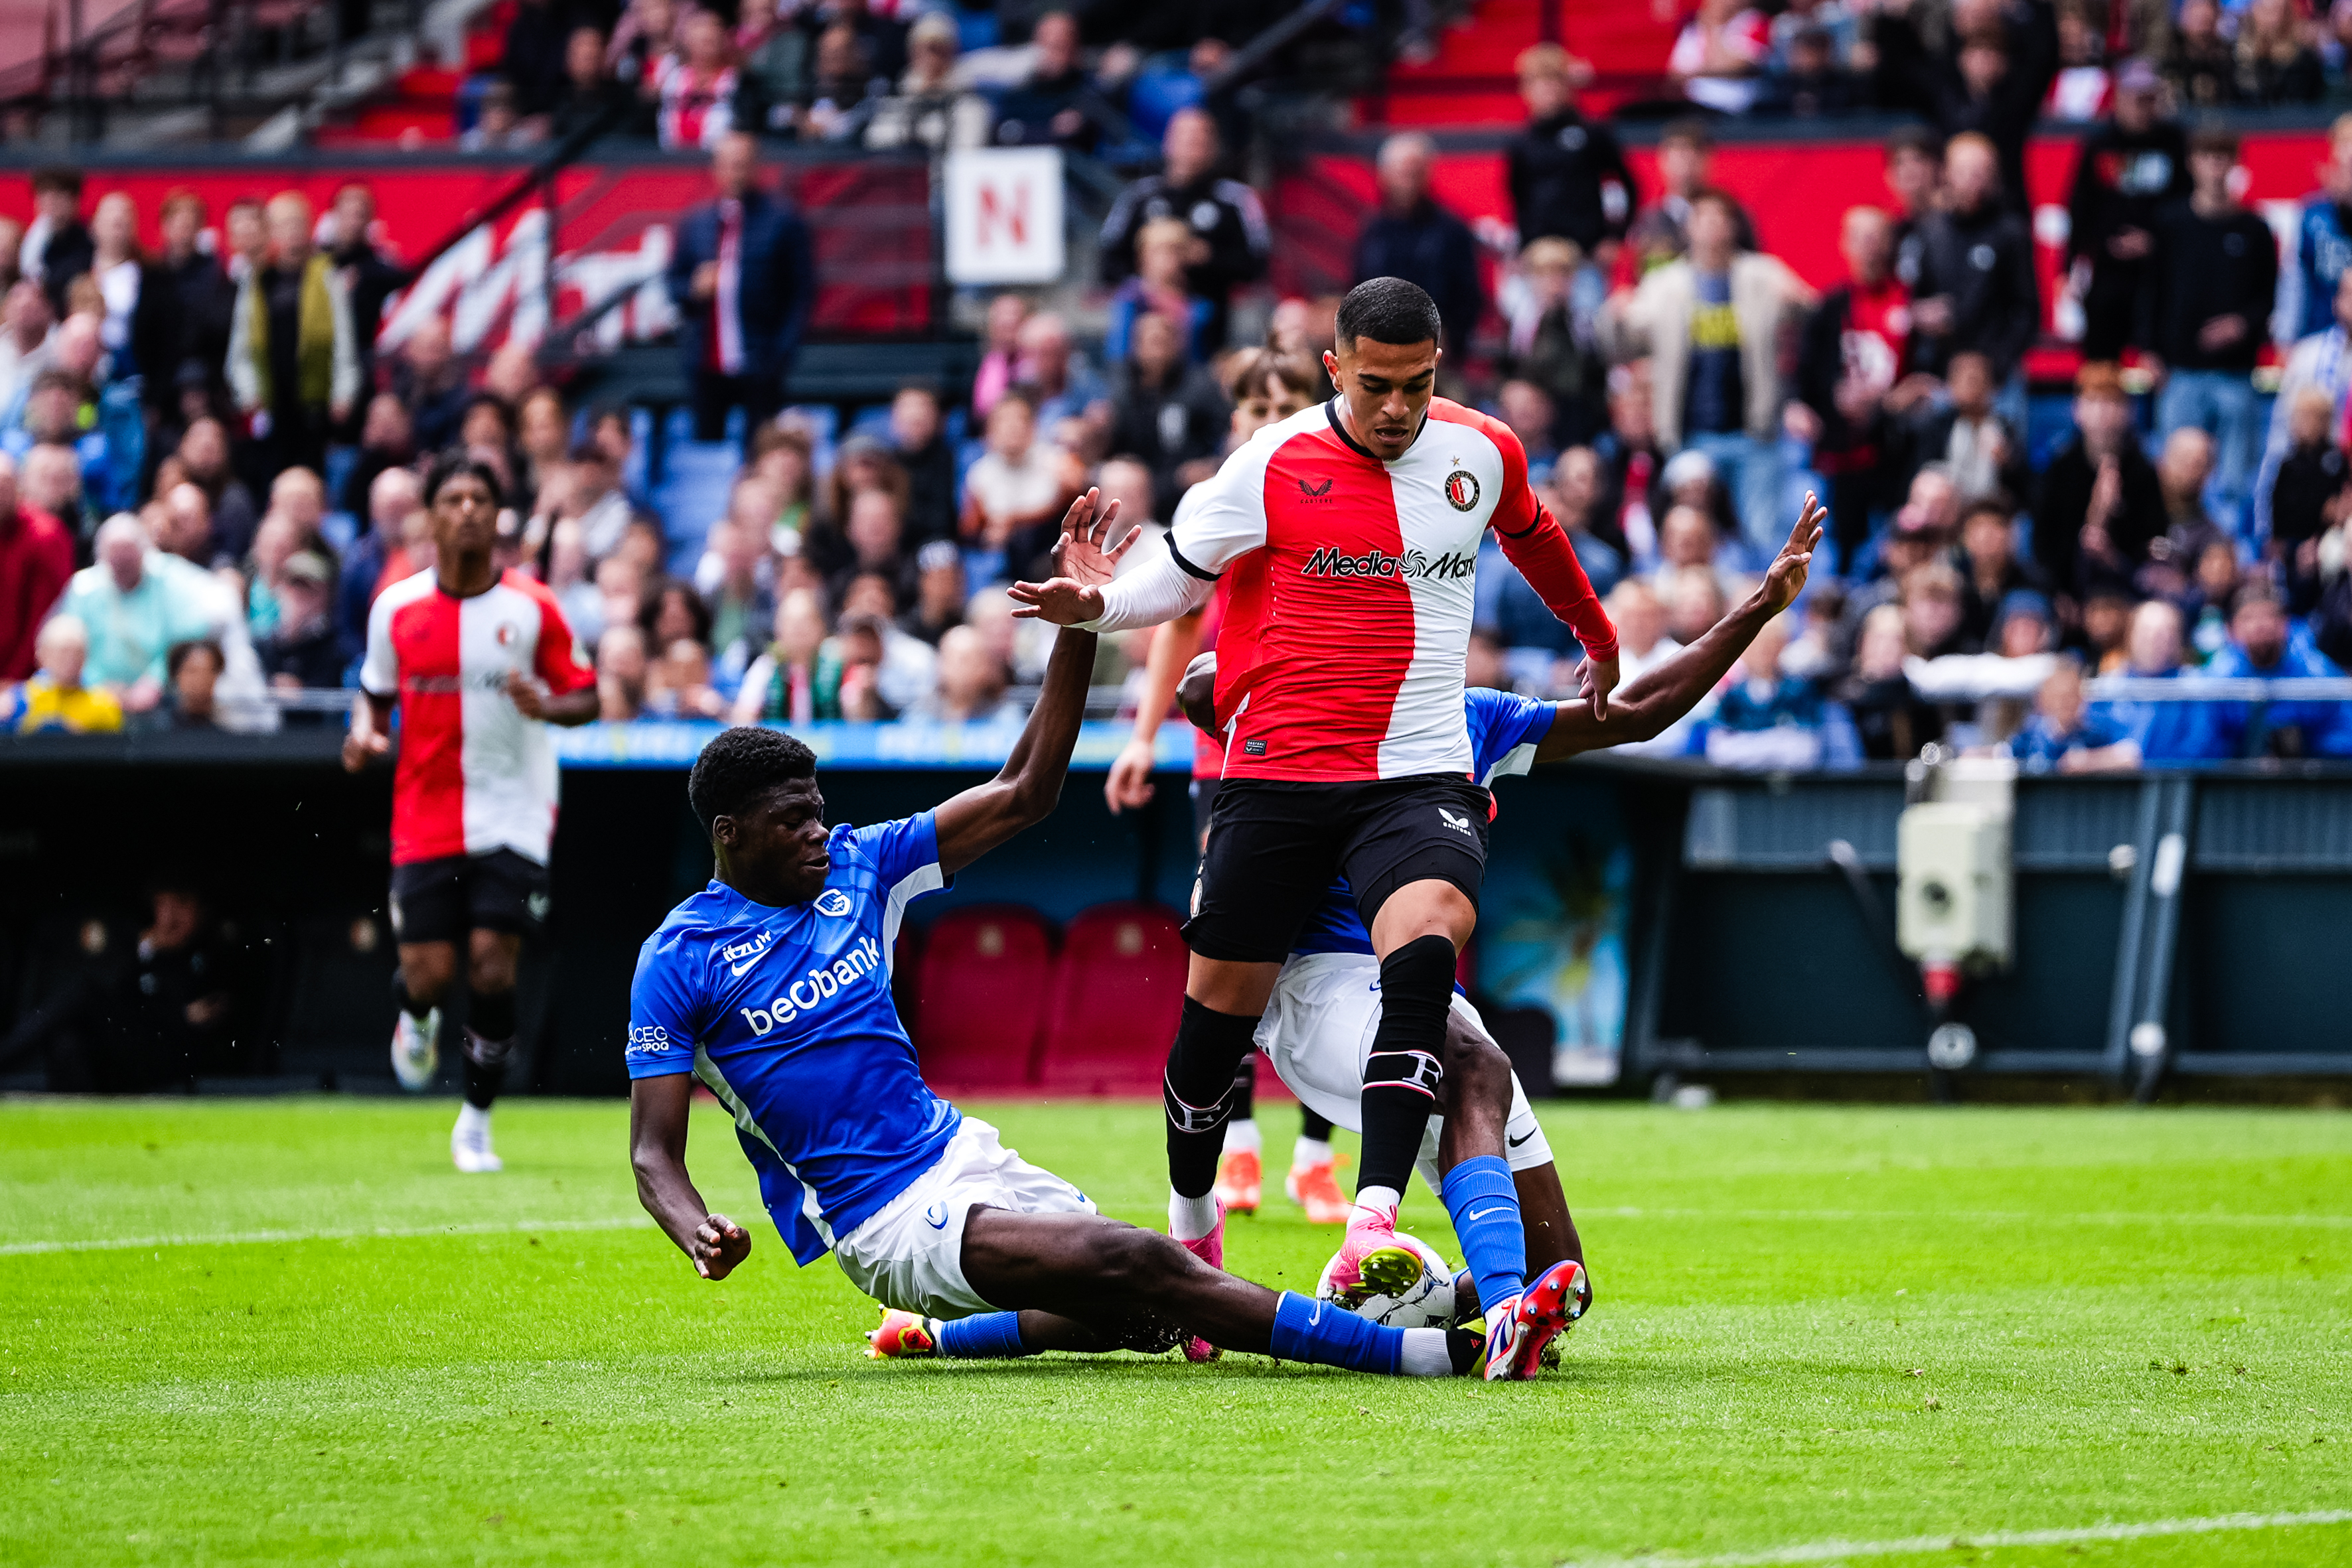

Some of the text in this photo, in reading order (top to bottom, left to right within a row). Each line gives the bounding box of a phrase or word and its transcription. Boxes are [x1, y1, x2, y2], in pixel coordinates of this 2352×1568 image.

[976, 180, 1030, 248] N
[1446, 471, 1477, 488] FEYENOORD
[1449, 493, 1479, 511] ROTTERDAM
[1301, 547, 1398, 577] Media
[642, 1041, 669, 1052] SPOQ
